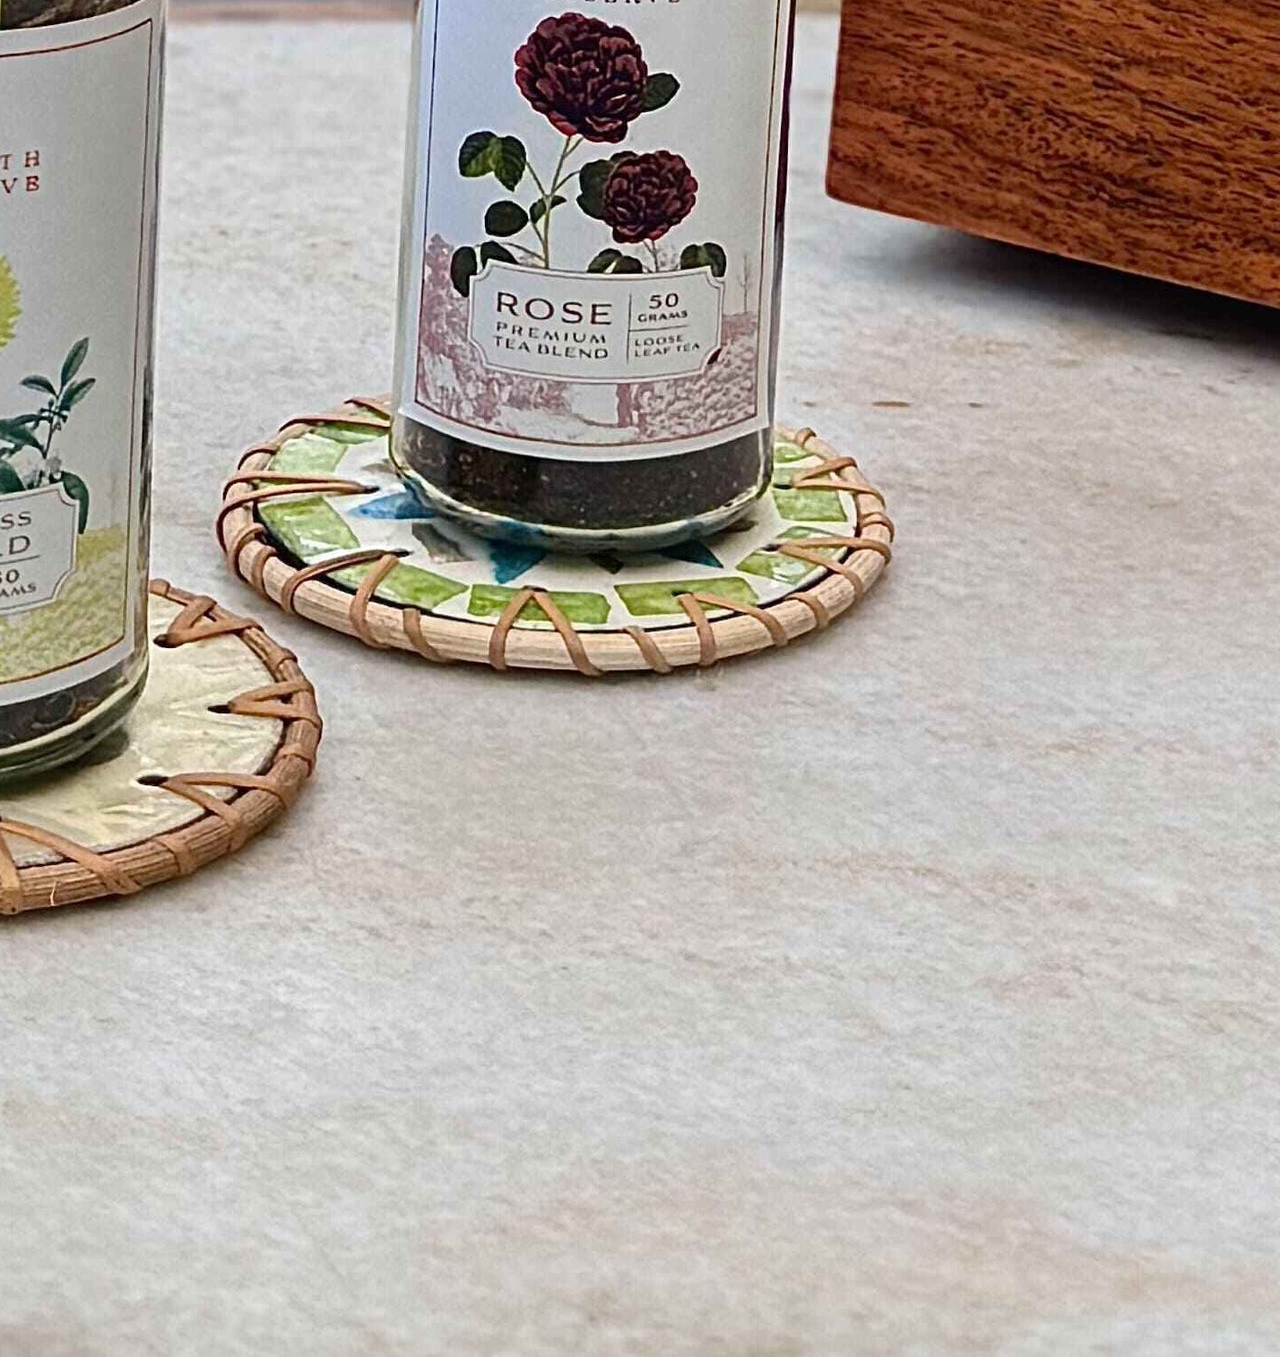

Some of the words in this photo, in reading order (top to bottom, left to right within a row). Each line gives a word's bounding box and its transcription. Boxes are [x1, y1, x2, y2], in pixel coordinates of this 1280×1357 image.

[495, 290, 614, 326] ROSE
[647, 291, 680, 310] 50
[636, 309, 690, 323] GRAMS
[495, 320, 608, 345] PREMIUM
[633, 333, 685, 348] LOOSE
[492, 334, 532, 354] TEA
[536, 341, 610, 360] BLEND
[633, 345, 671, 359] LEAF
[674, 341, 701, 354] TEA
